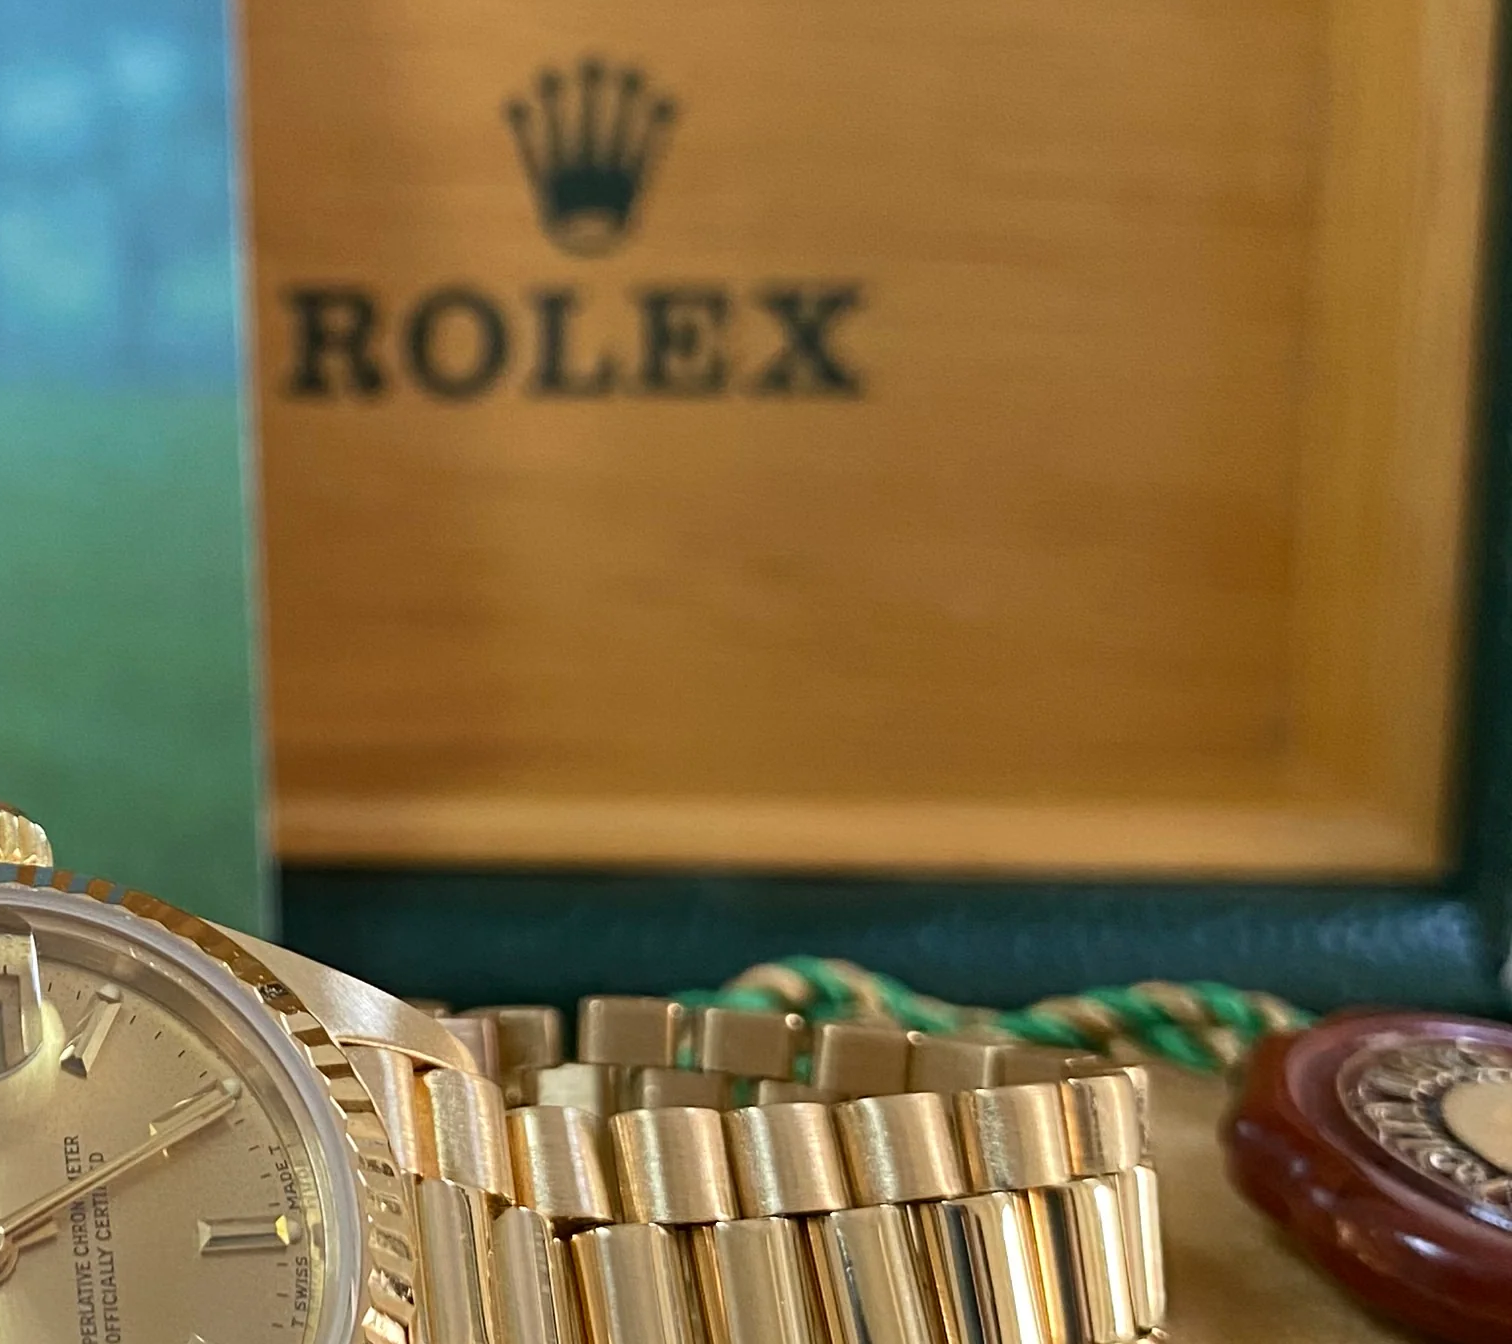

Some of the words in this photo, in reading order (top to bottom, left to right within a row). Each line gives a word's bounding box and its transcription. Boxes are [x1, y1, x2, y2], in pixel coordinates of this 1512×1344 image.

[282, 284, 866, 400] ROLEX
[64, 1134, 90, 1258] CHRONETER
[89, 1151, 112, 1243] CERTID
[275, 1159, 299, 1211] MADE
[96, 1246, 121, 1344] OFFICIALLY
[294, 1256, 309, 1313] SWISS
